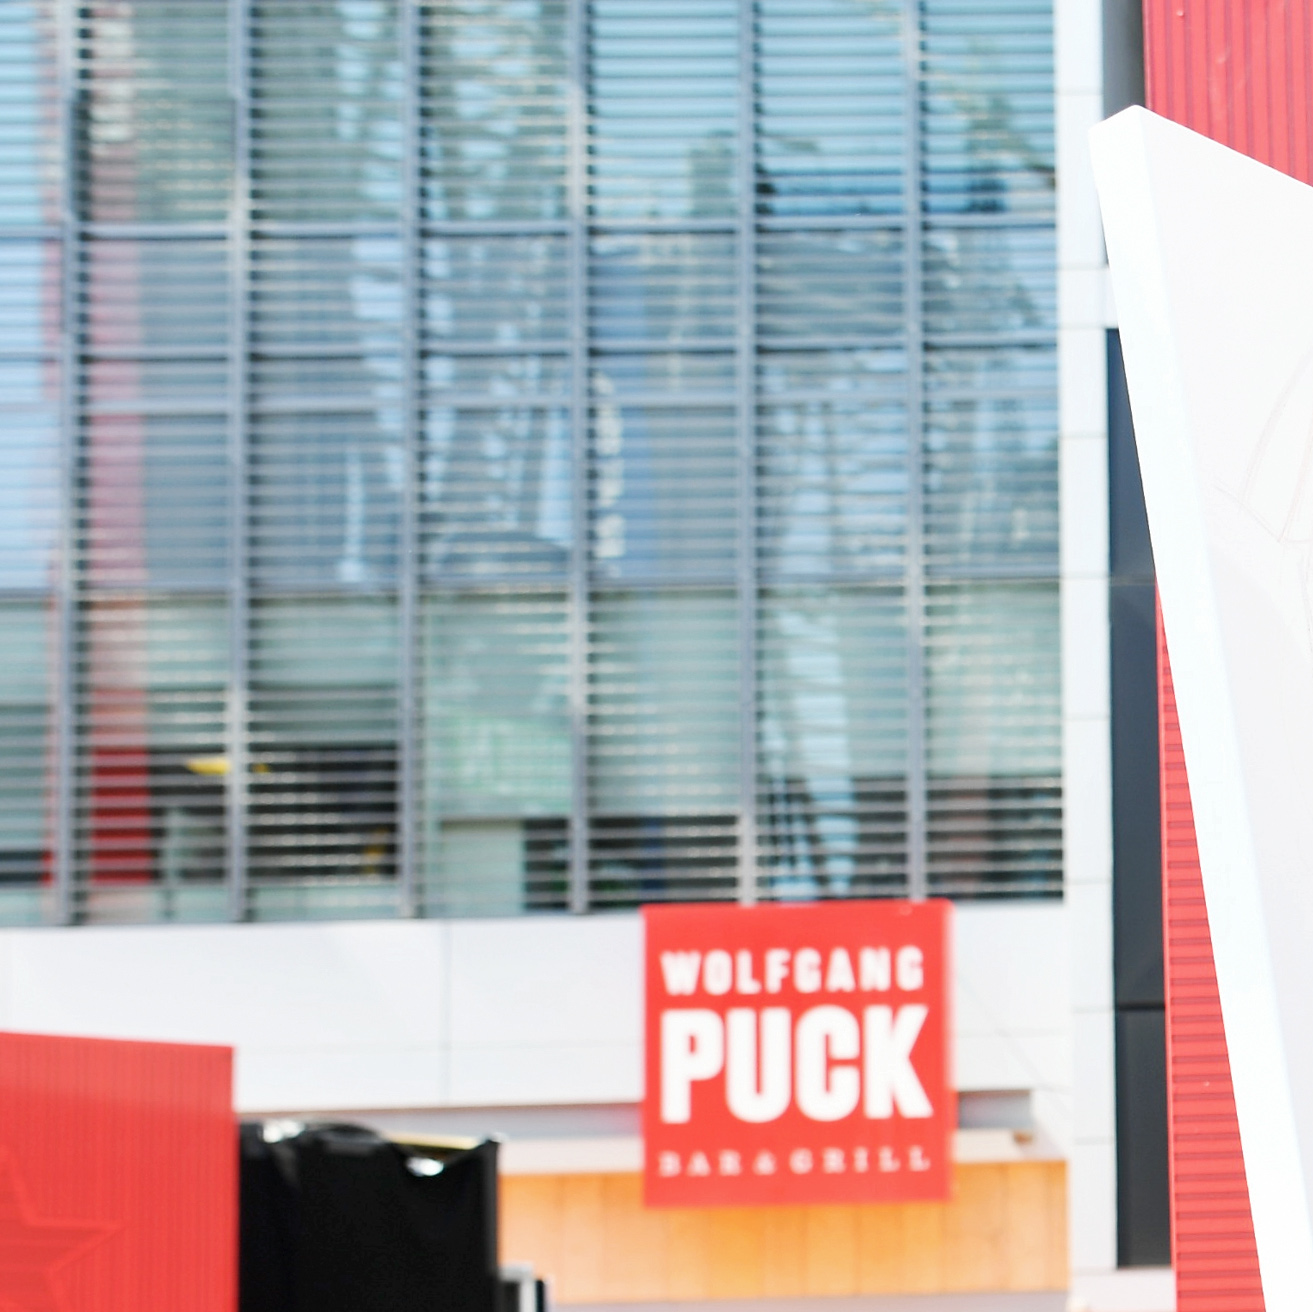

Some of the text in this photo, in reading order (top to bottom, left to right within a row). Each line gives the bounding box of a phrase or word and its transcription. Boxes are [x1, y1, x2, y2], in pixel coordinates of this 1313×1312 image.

[659, 945, 925, 996] WOLFGANG
[660, 1003, 934, 1124] PUCK
[658, 1145, 931, 1178] BAR & GRILL
